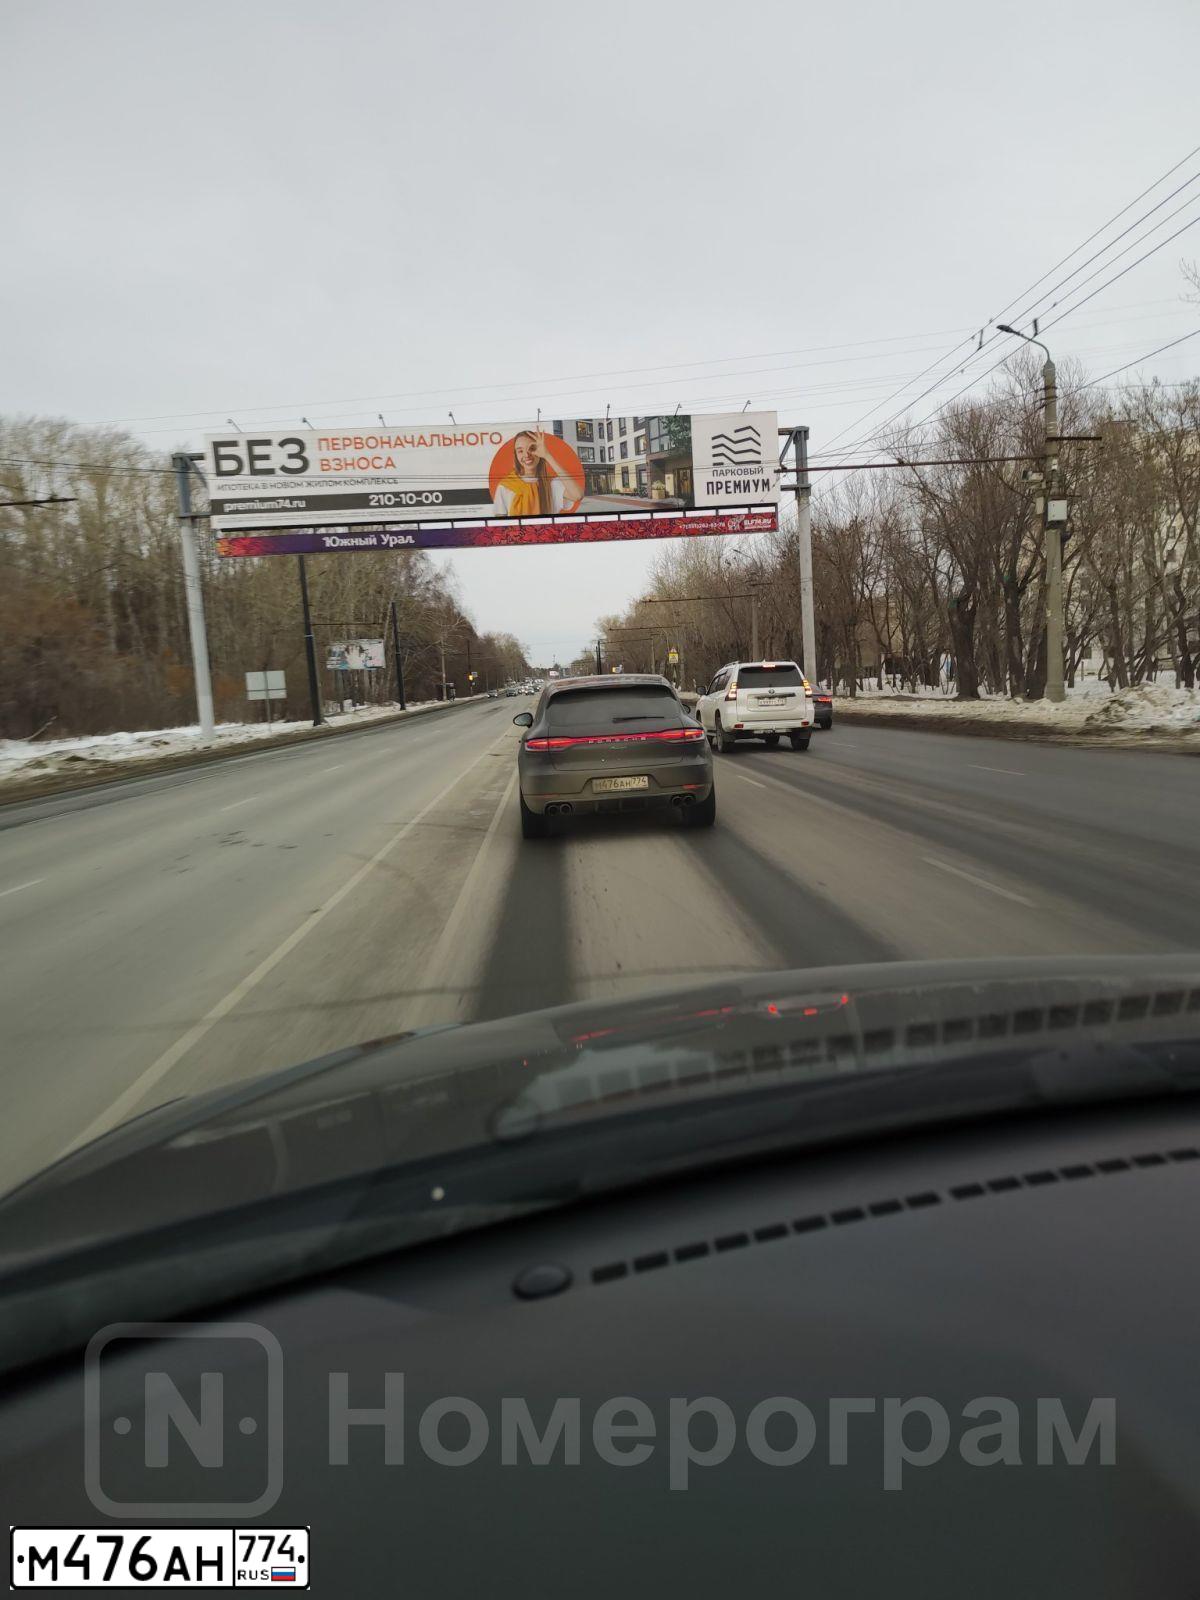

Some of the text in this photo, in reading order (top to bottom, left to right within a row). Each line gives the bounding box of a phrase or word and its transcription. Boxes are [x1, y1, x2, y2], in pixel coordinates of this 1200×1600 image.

[318, 431, 503, 452] ПЕРВОНАЧАЛЬНОГО
[212, 437, 310, 477] БЕЗ
[320, 456, 396, 472] ВЗНОСА
[712, 466, 764, 478] ПАРКОВЫЙ
[269, 481, 304, 489] НОВОМ
[305, 479, 342, 488] ЖИЛОМ
[343, 477, 399, 487] КОМПЛЕКСЕ
[706, 478, 771, 496] ПРЕМИУМ
[223, 499, 306, 513] premium74.ru
[368, 492, 443, 507] 210-10-00
[323, 533, 415, 548] Южный Урал
